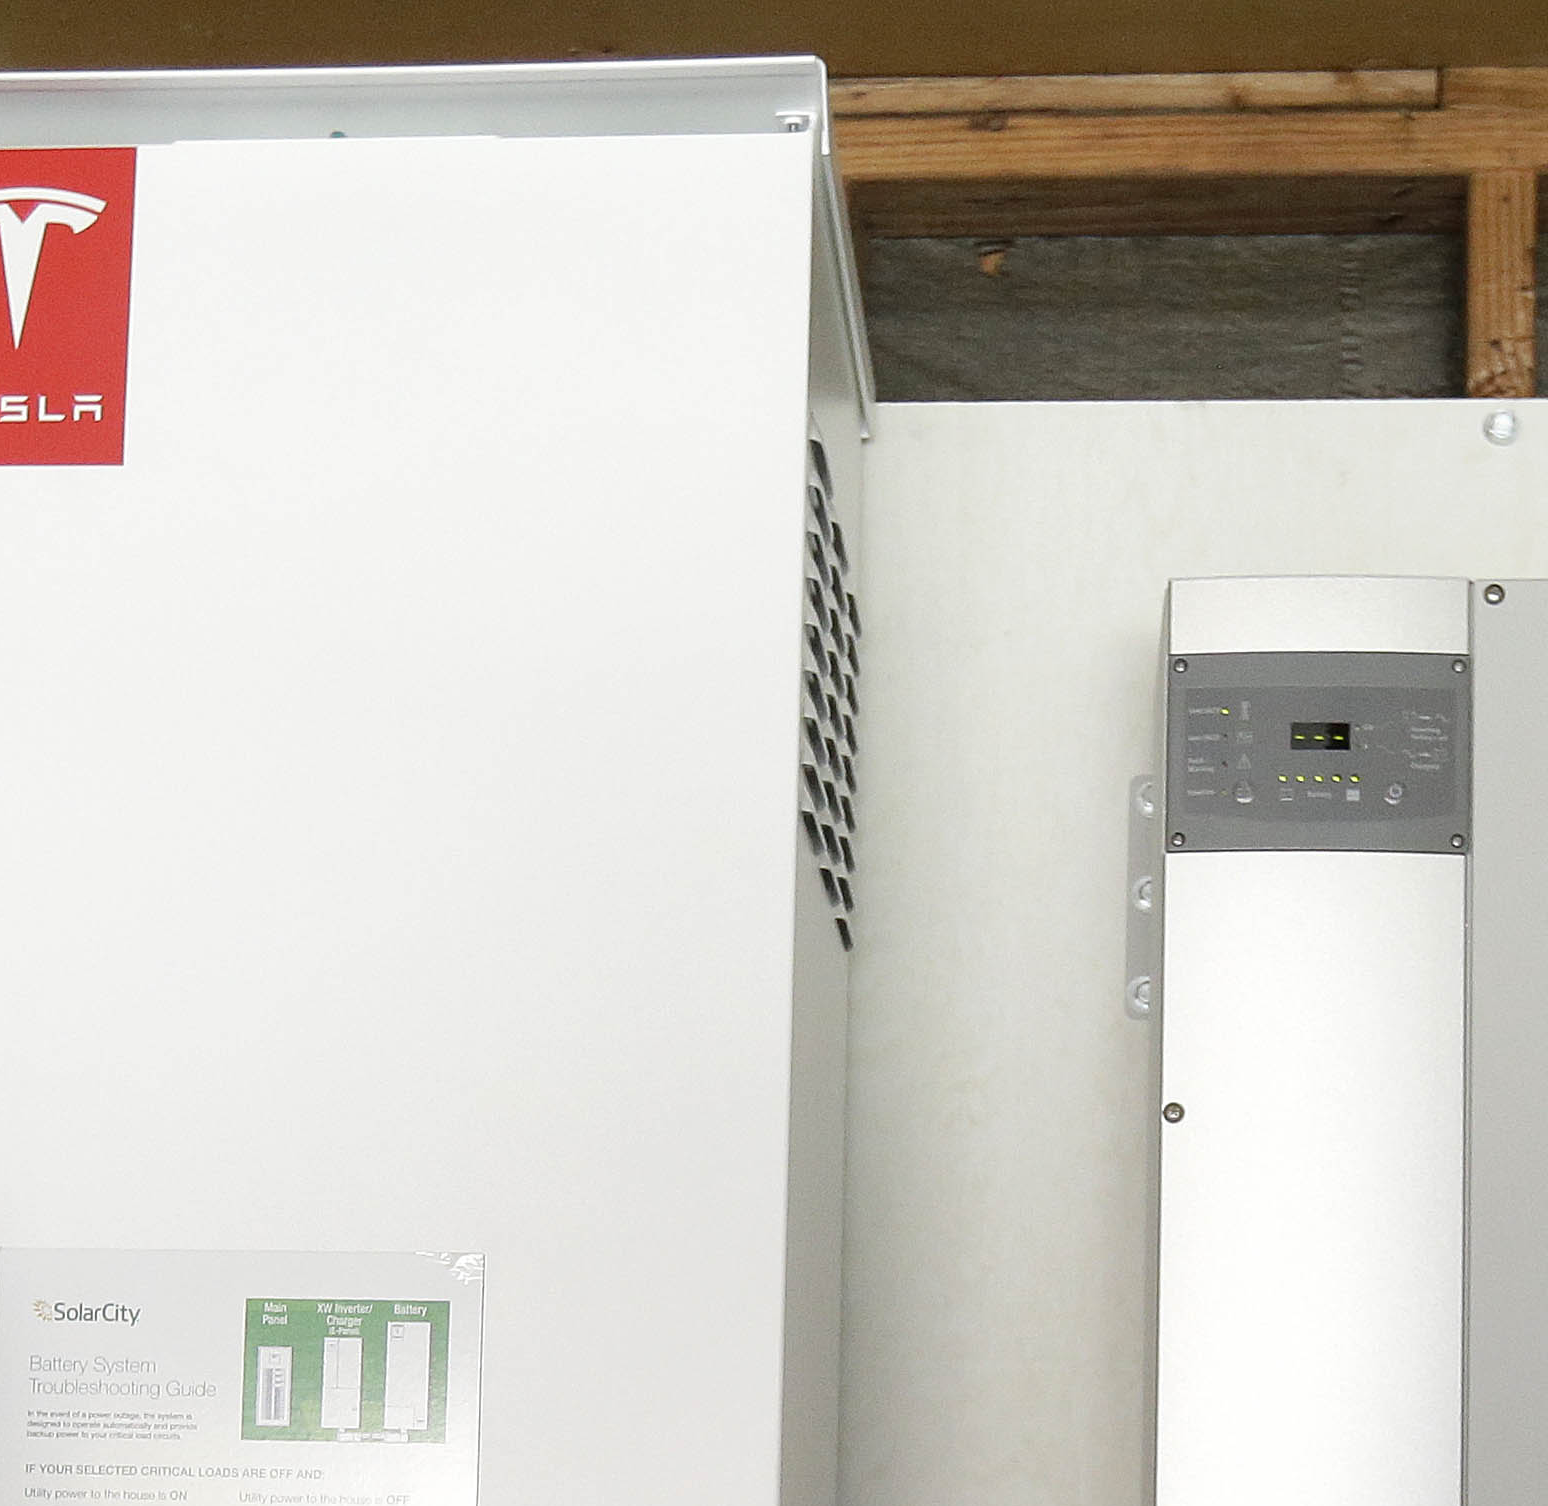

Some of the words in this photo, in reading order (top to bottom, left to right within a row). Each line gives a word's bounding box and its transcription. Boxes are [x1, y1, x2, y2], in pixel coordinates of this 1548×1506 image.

[54, 1302, 141, 1326] SolarCity
[29, 1355, 88, 1374] Battery
[93, 1356, 157, 1376] System
[28, 1377, 160, 1400] Troubleshooting
[166, 1380, 217, 1398] Guide
[25, 1464, 35, 1473] IF
[39, 1464, 73, 1475] YOUR
[76, 1464, 137, 1476] SELECTED
[140, 1466, 195, 1477] CRITICAL
[198, 1467, 239, 1478] LOADS
[242, 1468, 267, 1479] ARE
[270, 1469, 293, 1479] OFF
[25, 1487, 51, 1500] Utility
[55, 1490, 87, 1501] power
[90, 1489, 100, 1499] to
[104, 1489, 121, 1499] the
[123, 1490, 156, 1500] house
[169, 1491, 188, 1501] ON
[270, 1494, 305, 1505] power
[386, 1494, 411, 1505] OFF
